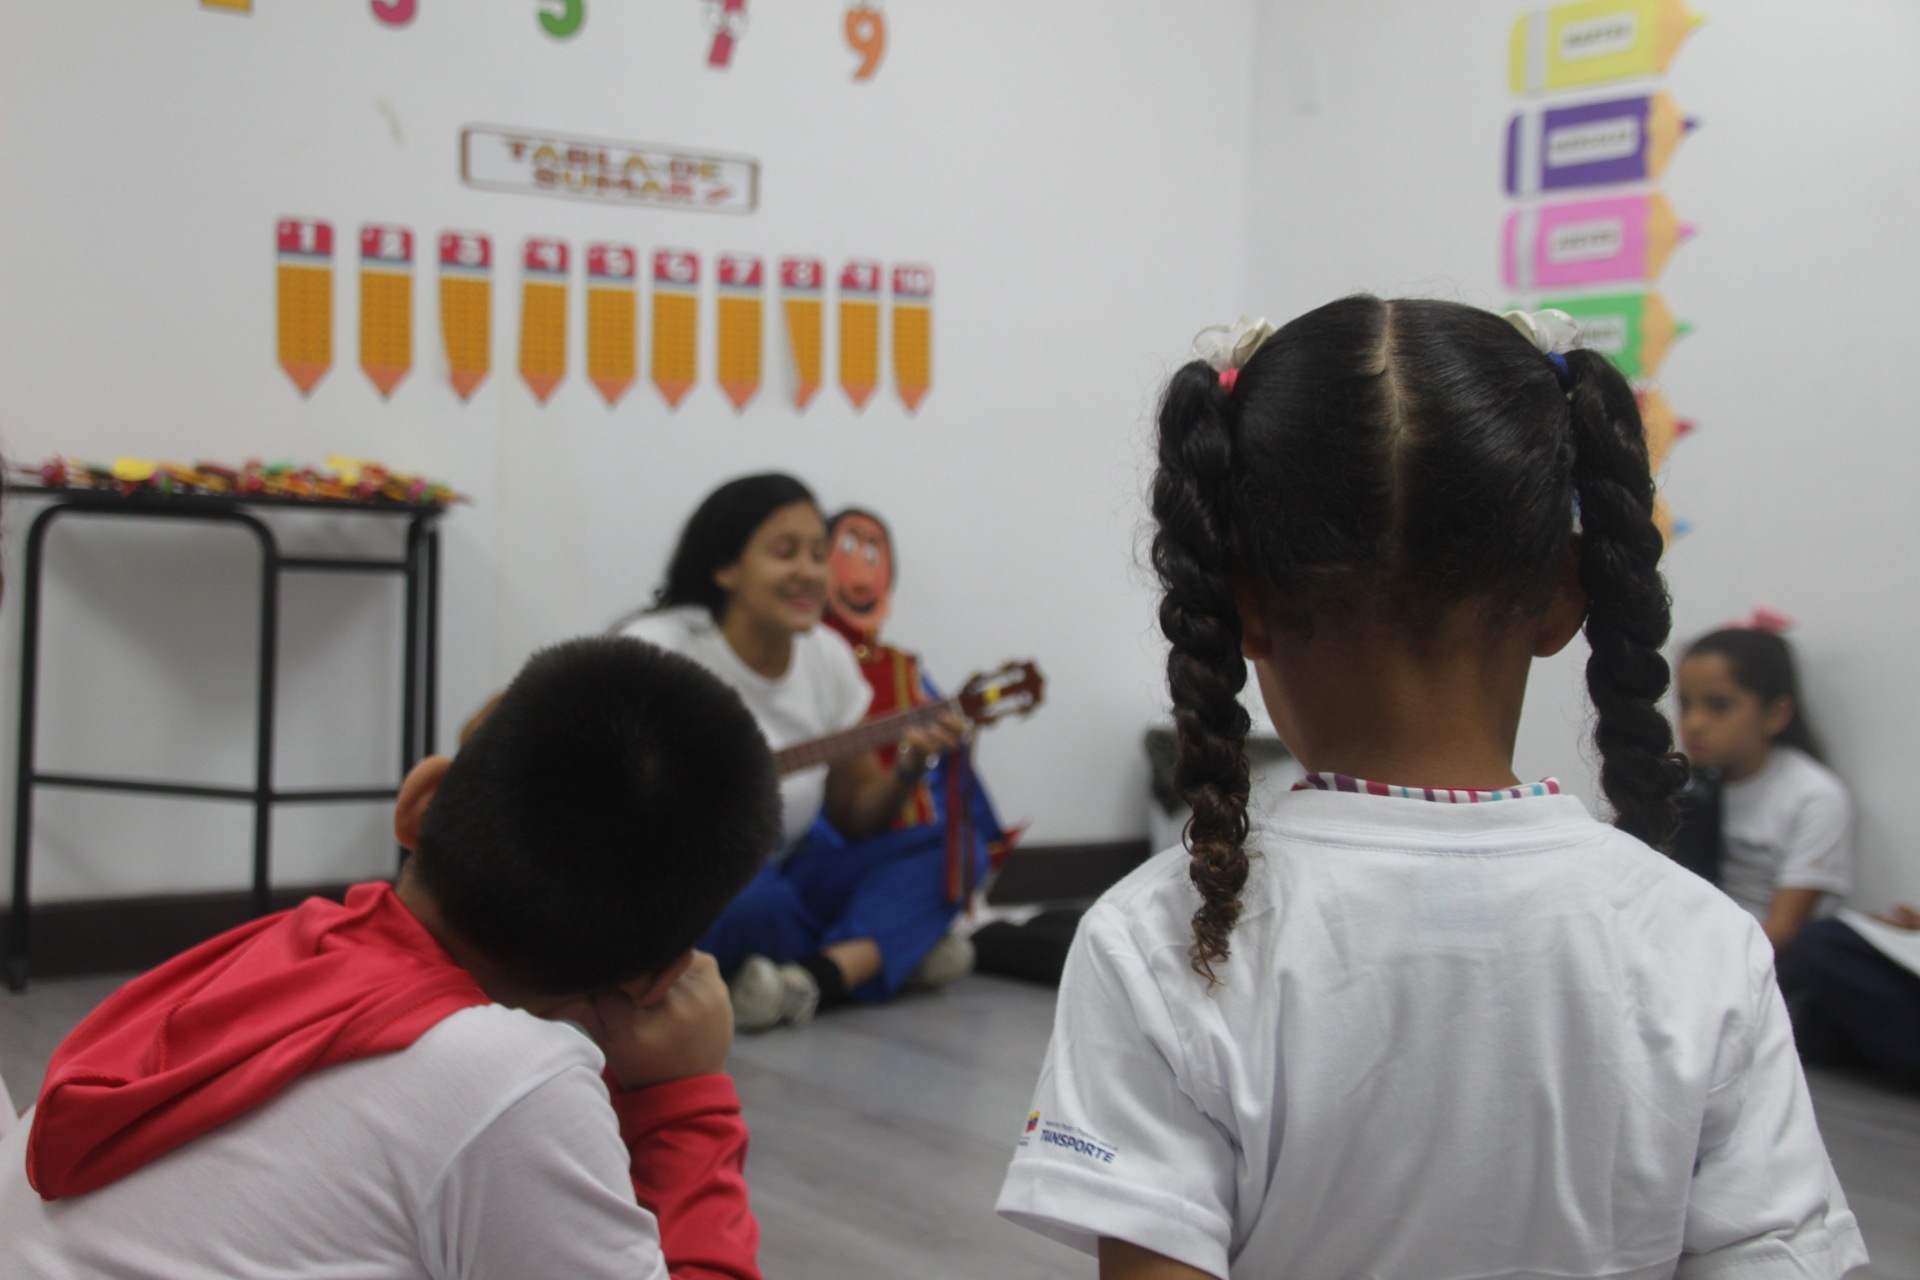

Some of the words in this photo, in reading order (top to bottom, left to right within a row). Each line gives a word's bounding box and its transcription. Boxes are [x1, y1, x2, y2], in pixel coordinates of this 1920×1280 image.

[844, 4, 887, 81] 9
[298, 220, 317, 253] 1
[377, 228, 406, 259] 2
[455, 236, 483, 267] 3
[534, 242, 560, 271] 4
[603, 248, 631, 278] 5
[667, 252, 693, 281] 6
[733, 258, 756, 284] 7
[792, 260, 815, 287] 8
[851, 264, 872, 290] 9
[903, 268, 927, 292] 10
